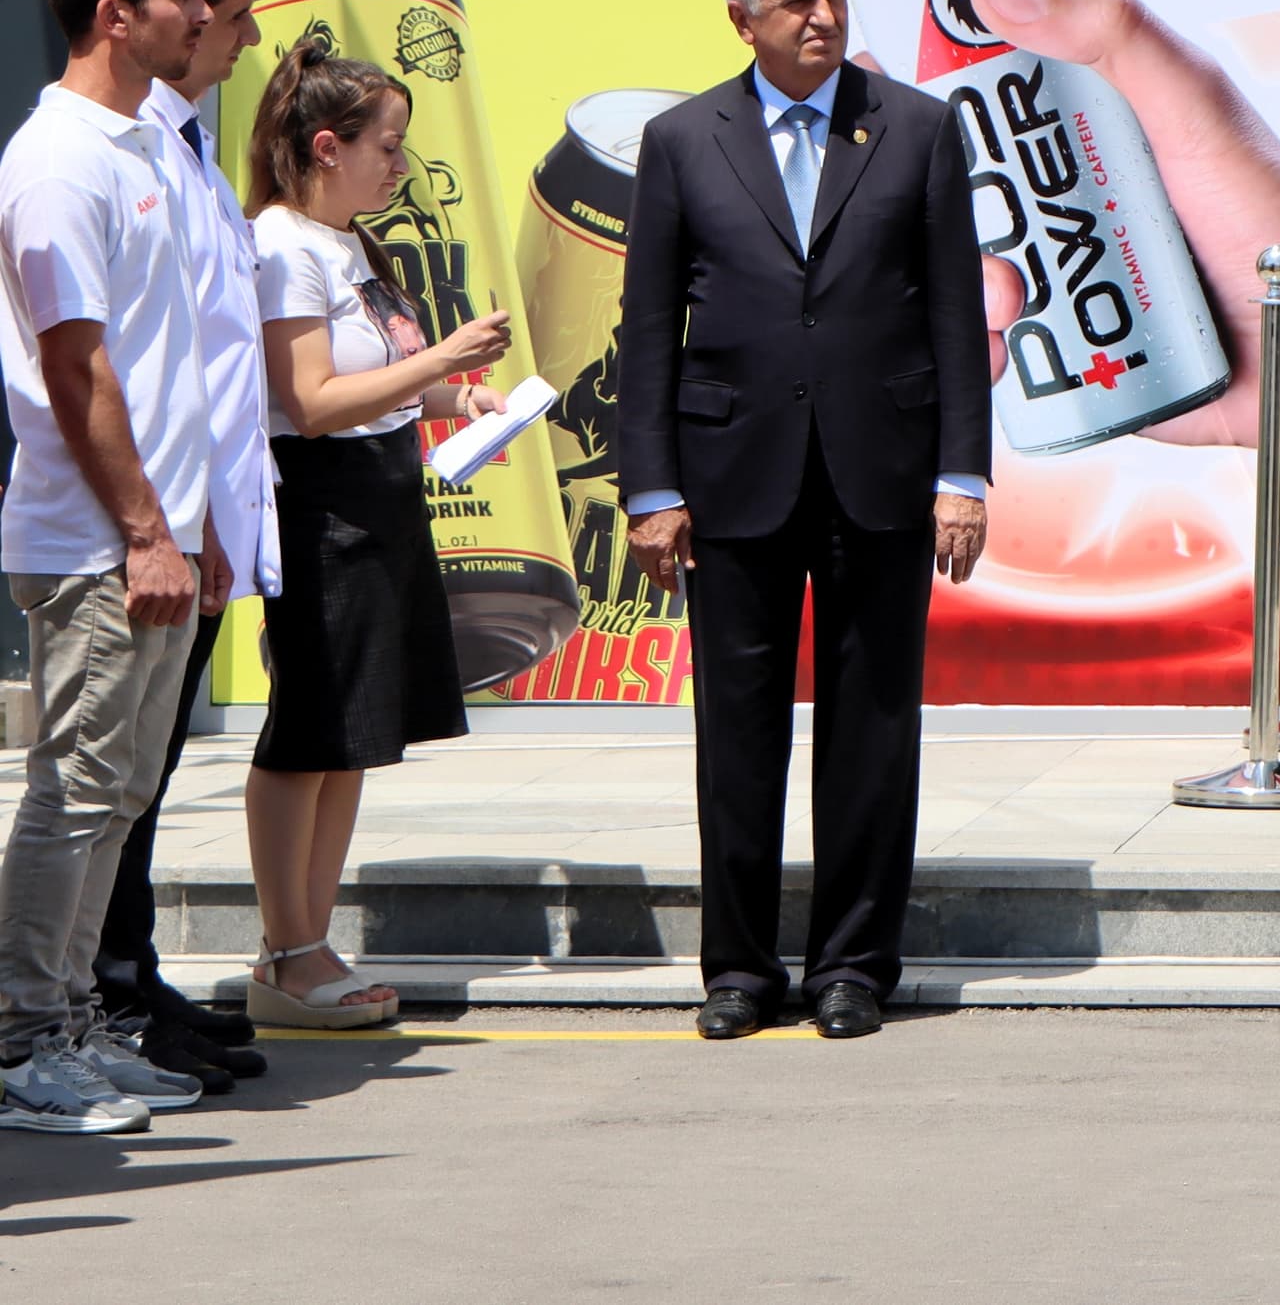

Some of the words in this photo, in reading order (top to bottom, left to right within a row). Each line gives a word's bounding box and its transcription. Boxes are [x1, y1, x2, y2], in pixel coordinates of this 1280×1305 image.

[402, 29, 456, 62] ORIGINAL
[1073, 112, 1109, 186] CAFFEIN
[572, 200, 625, 233] STRONG
[1113, 226, 1127, 239] C
[1118, 241, 1153, 314] VITAMIN
[424, 477, 473, 497] NAL
[437, 535, 478, 549] L.OZ.)
[460, 559, 526, 573] VITAMINE
